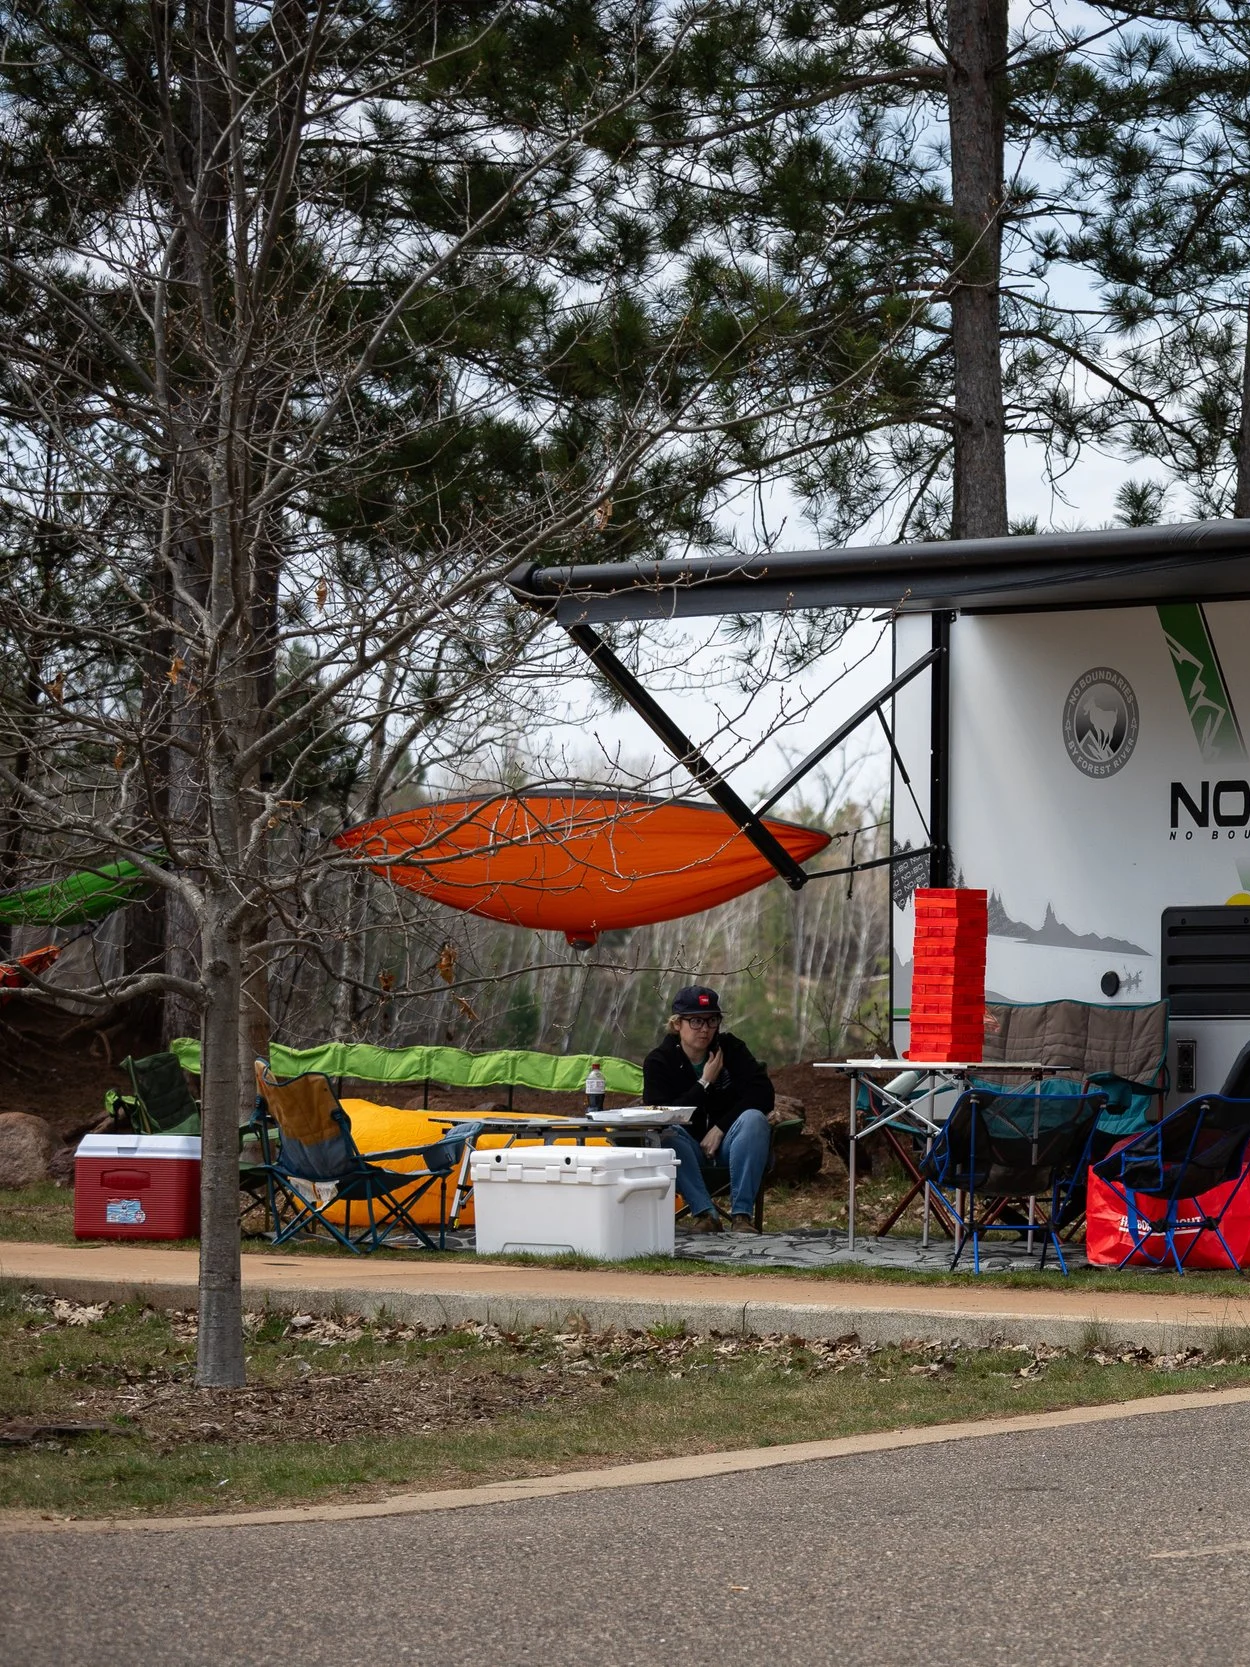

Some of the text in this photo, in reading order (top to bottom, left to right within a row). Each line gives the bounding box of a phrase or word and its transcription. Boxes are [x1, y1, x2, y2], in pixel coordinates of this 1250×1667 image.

[1068, 670, 1134, 705] NO BOUNDARIES
[1068, 737, 1135, 775] BY FOREST RIVER
[1169, 830, 1193, 841] NO
